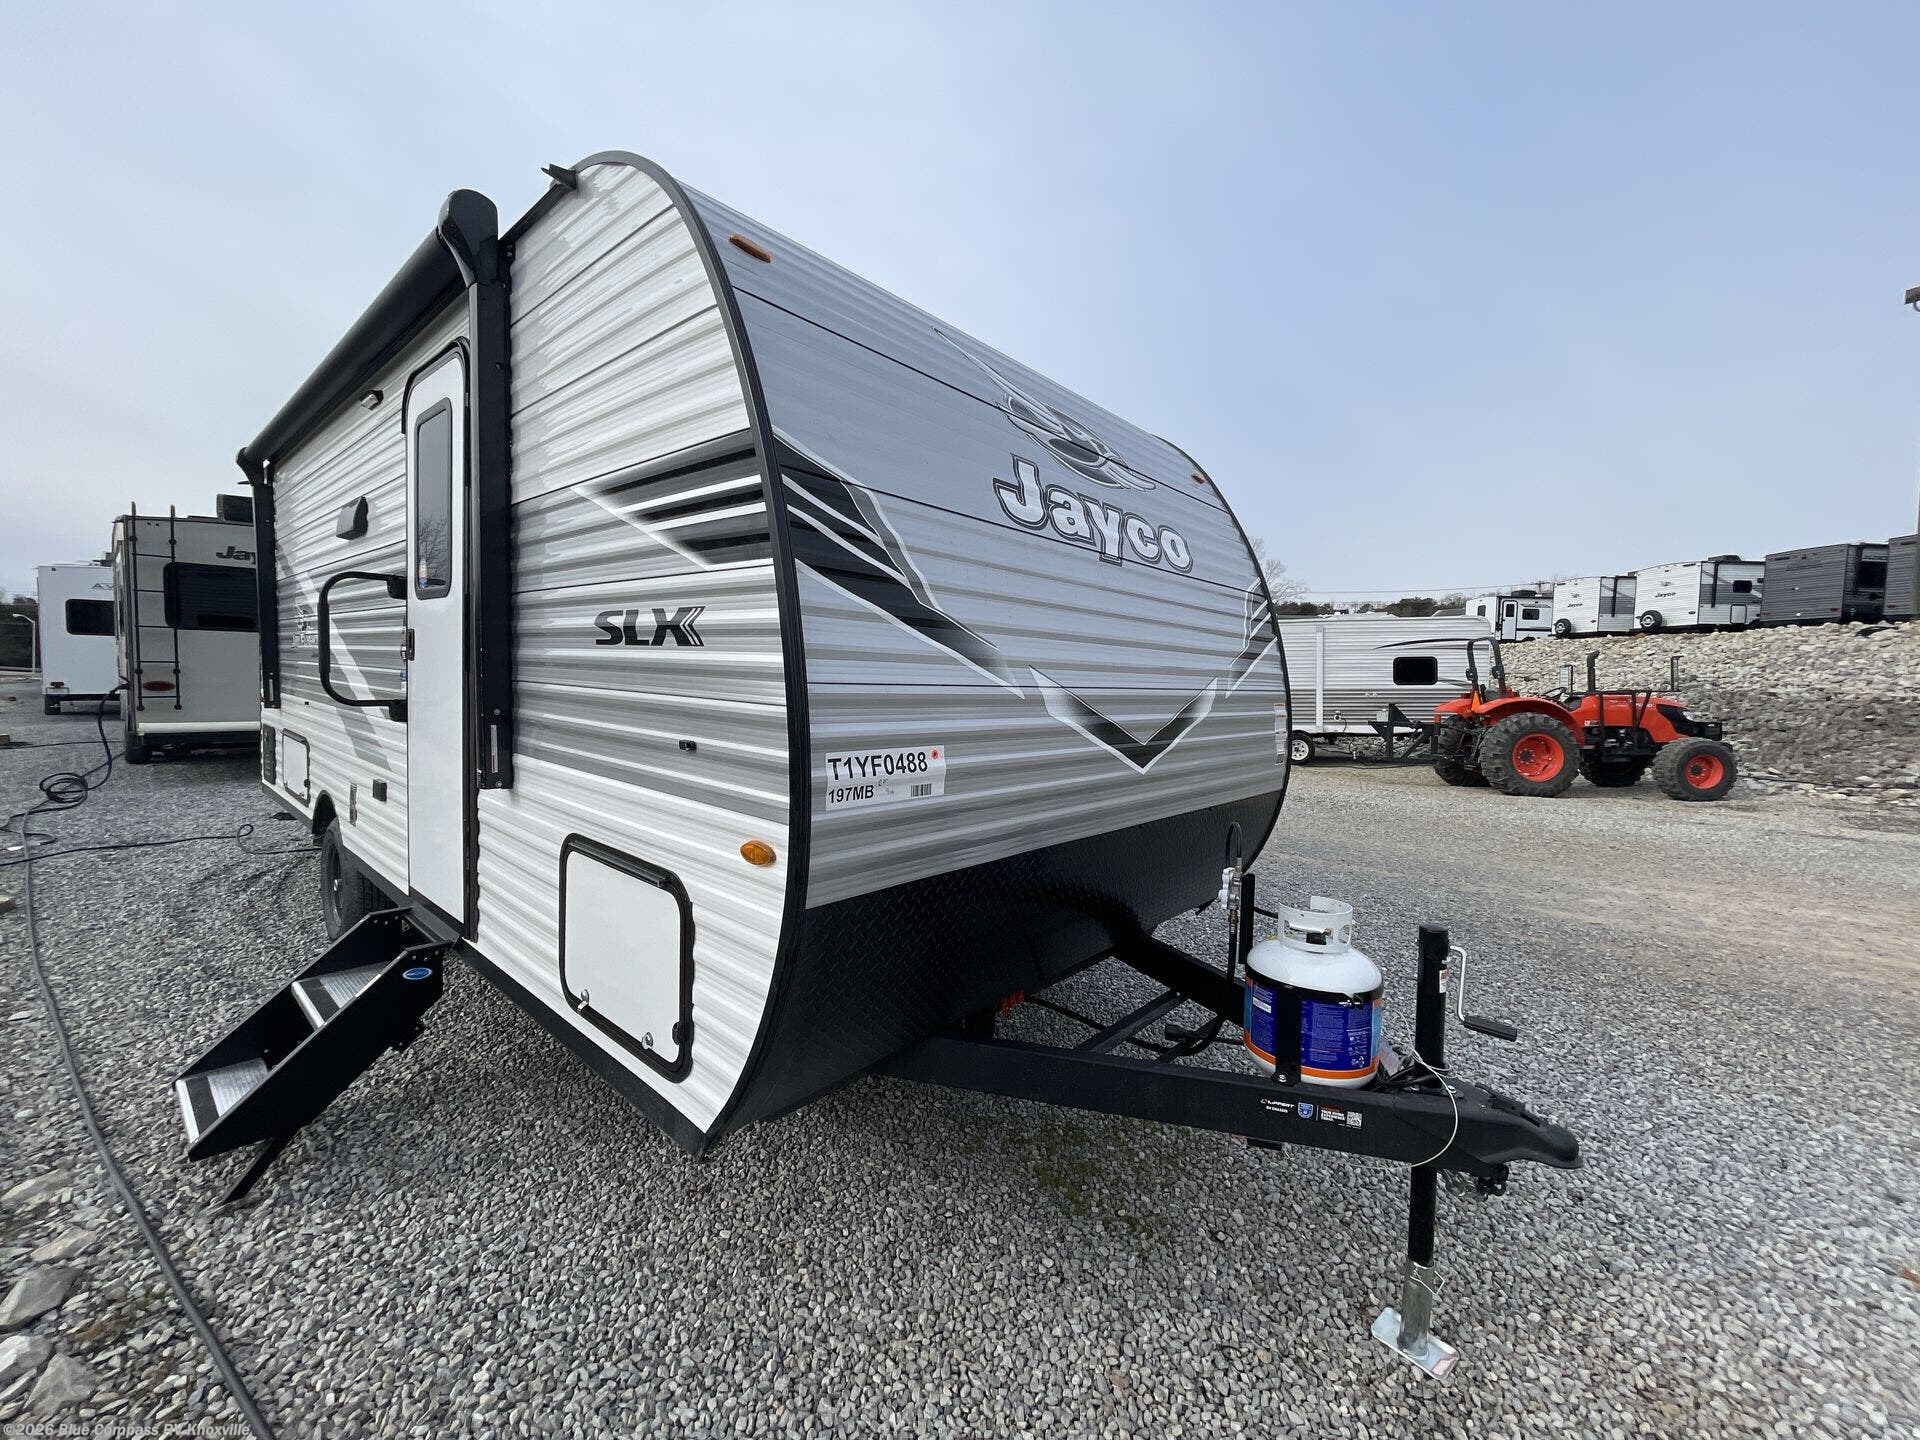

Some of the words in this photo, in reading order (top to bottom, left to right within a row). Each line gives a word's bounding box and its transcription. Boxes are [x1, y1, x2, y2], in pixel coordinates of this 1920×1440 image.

[993, 453, 1193, 574] Jayco
[594, 606, 706, 647] SLX
[827, 751, 929, 780] T1YF0488
[828, 784, 875, 804] 197MB
